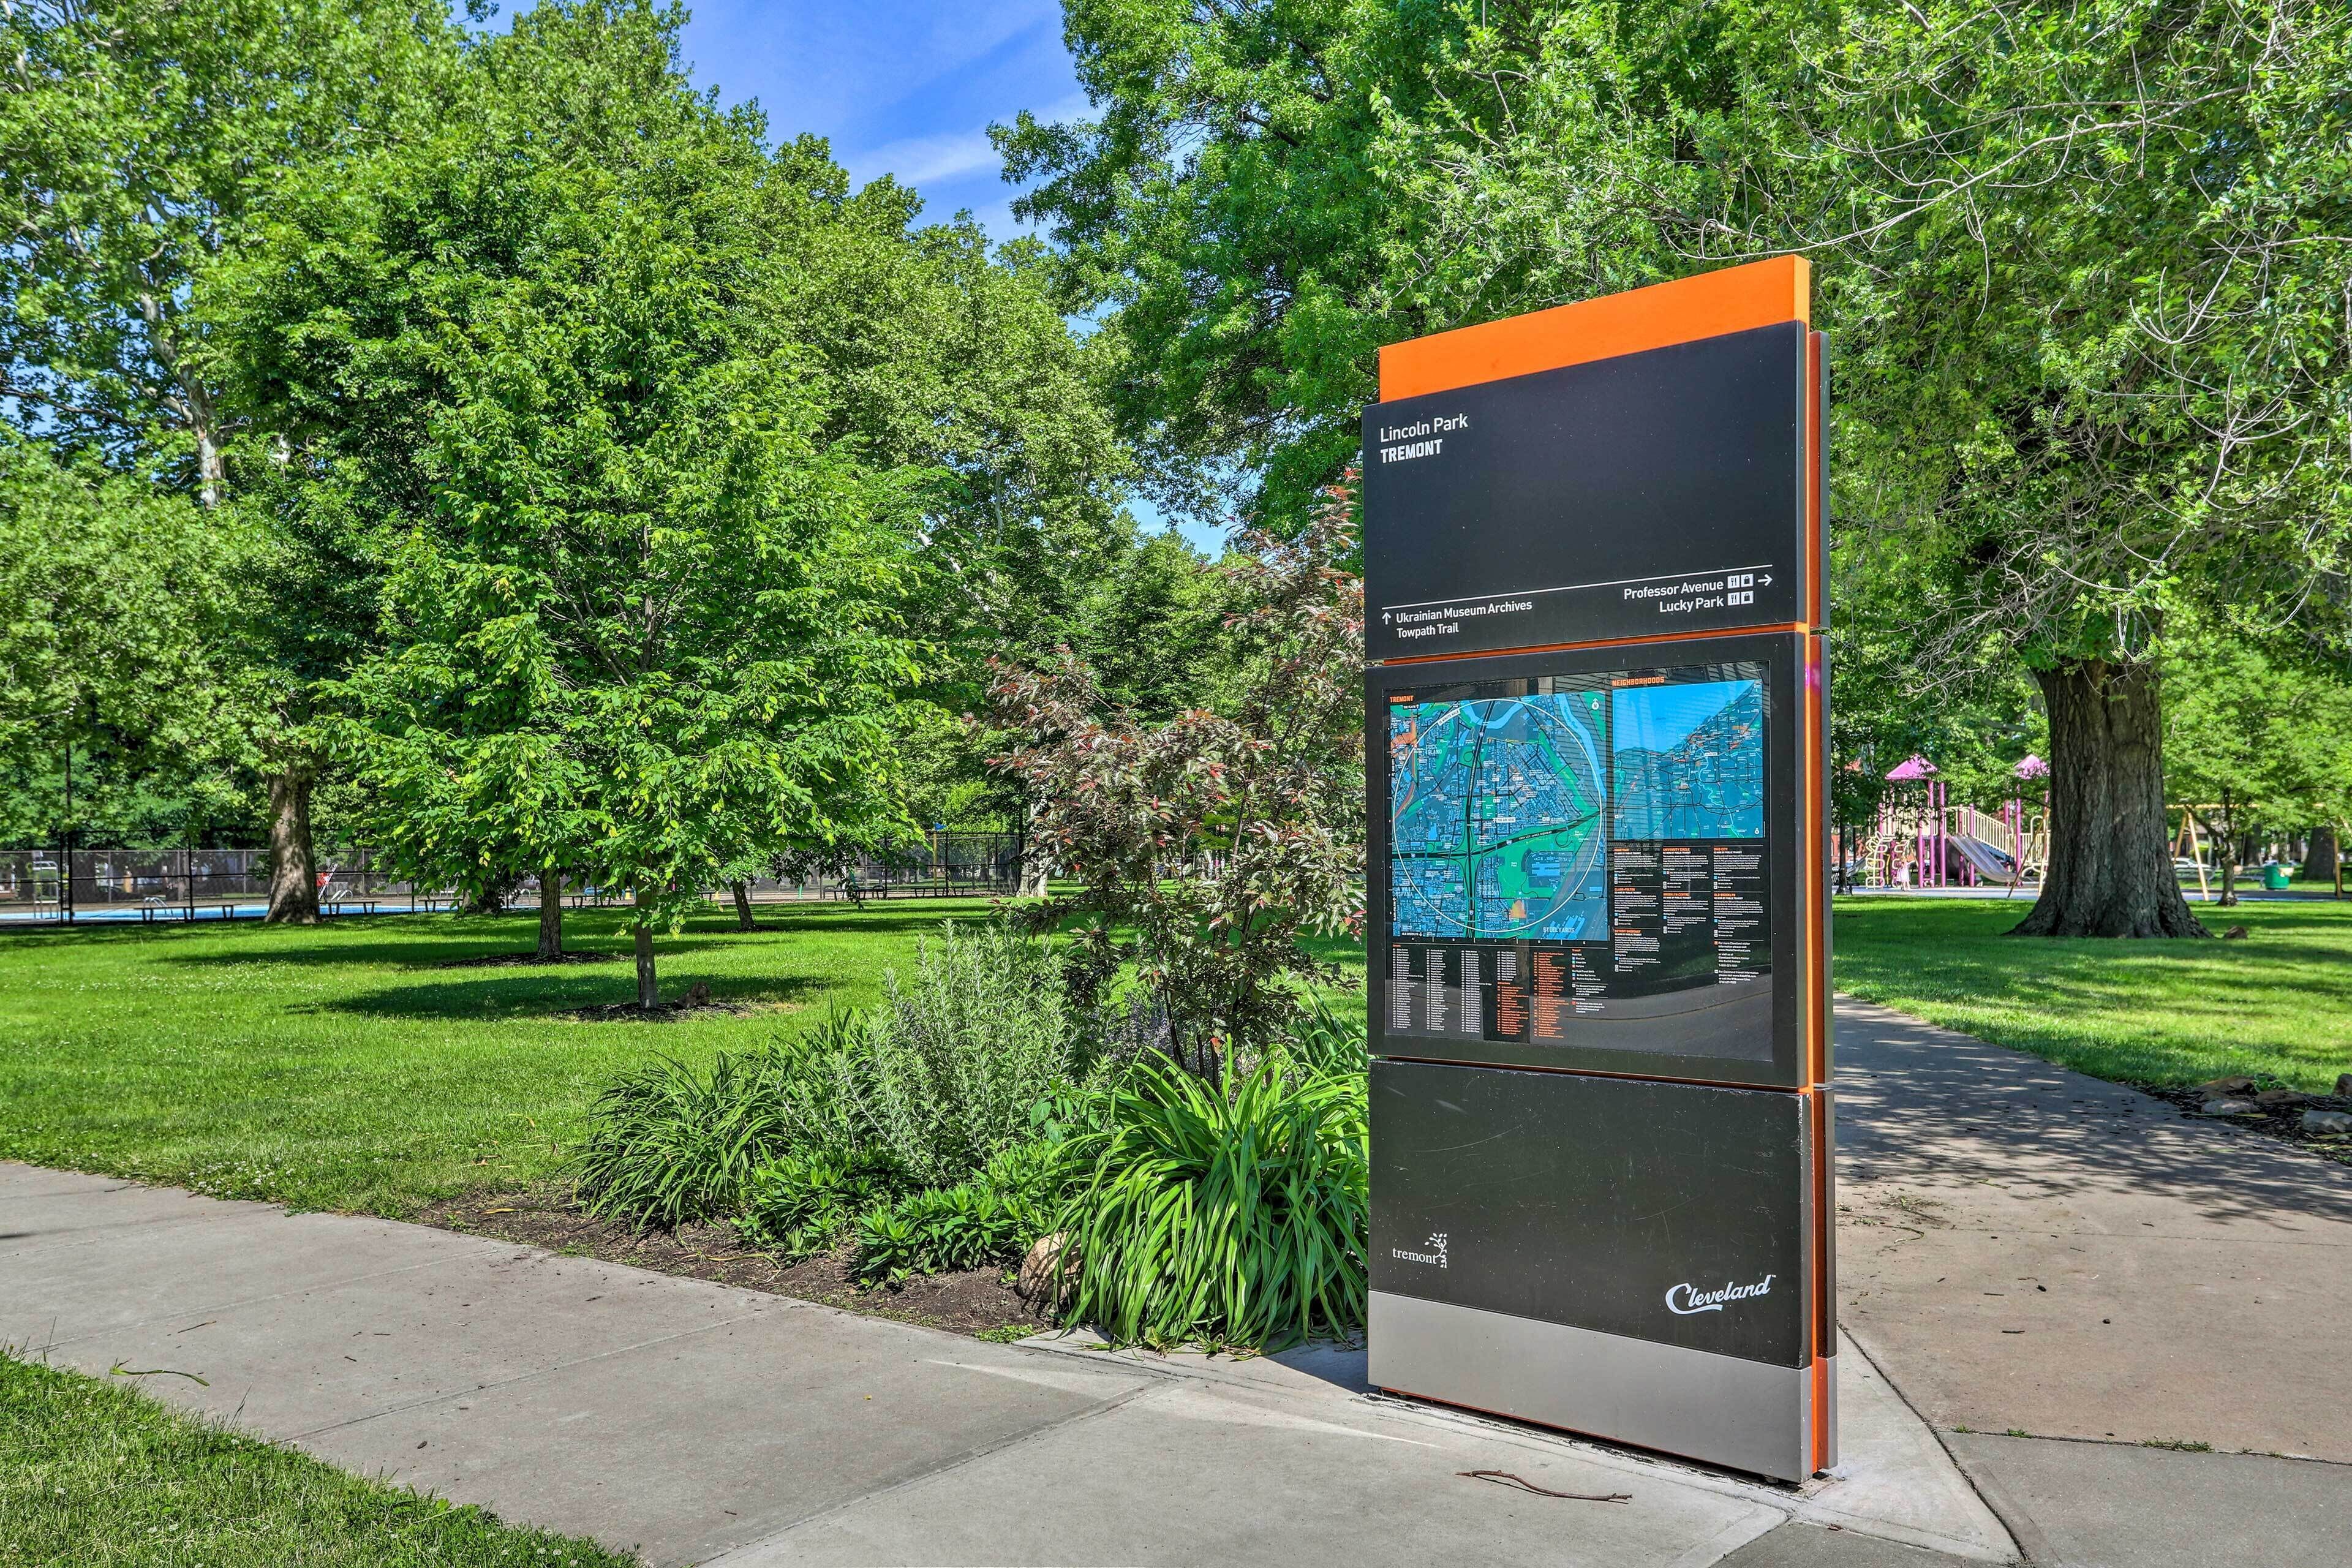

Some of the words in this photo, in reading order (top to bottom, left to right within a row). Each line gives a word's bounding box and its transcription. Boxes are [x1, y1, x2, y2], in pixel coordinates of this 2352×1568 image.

[1381, 421, 1430, 443] Lincoln
[1434, 413, 1469, 433] Park
[1380, 439, 1443, 464] TREMONT
[1624, 585, 1680, 600] Professor
[1680, 581, 1724, 594] Avenue
[1396, 609, 1442, 624] Ukrainian
[1444, 606, 1487, 619] Museum
[1487, 600, 1533, 614] Archives
[1659, 599, 1694, 613] Lucky
[1695, 595, 1724, 609] Park
[1396, 624, 1436, 639] Towpath
[1436, 622, 1460, 635] Trail
[1612, 676, 1665, 687] NEIGHBORHOODS
[1392, 1247, 1437, 1265] tremont
[1665, 1274, 1772, 1314] Cleveland
